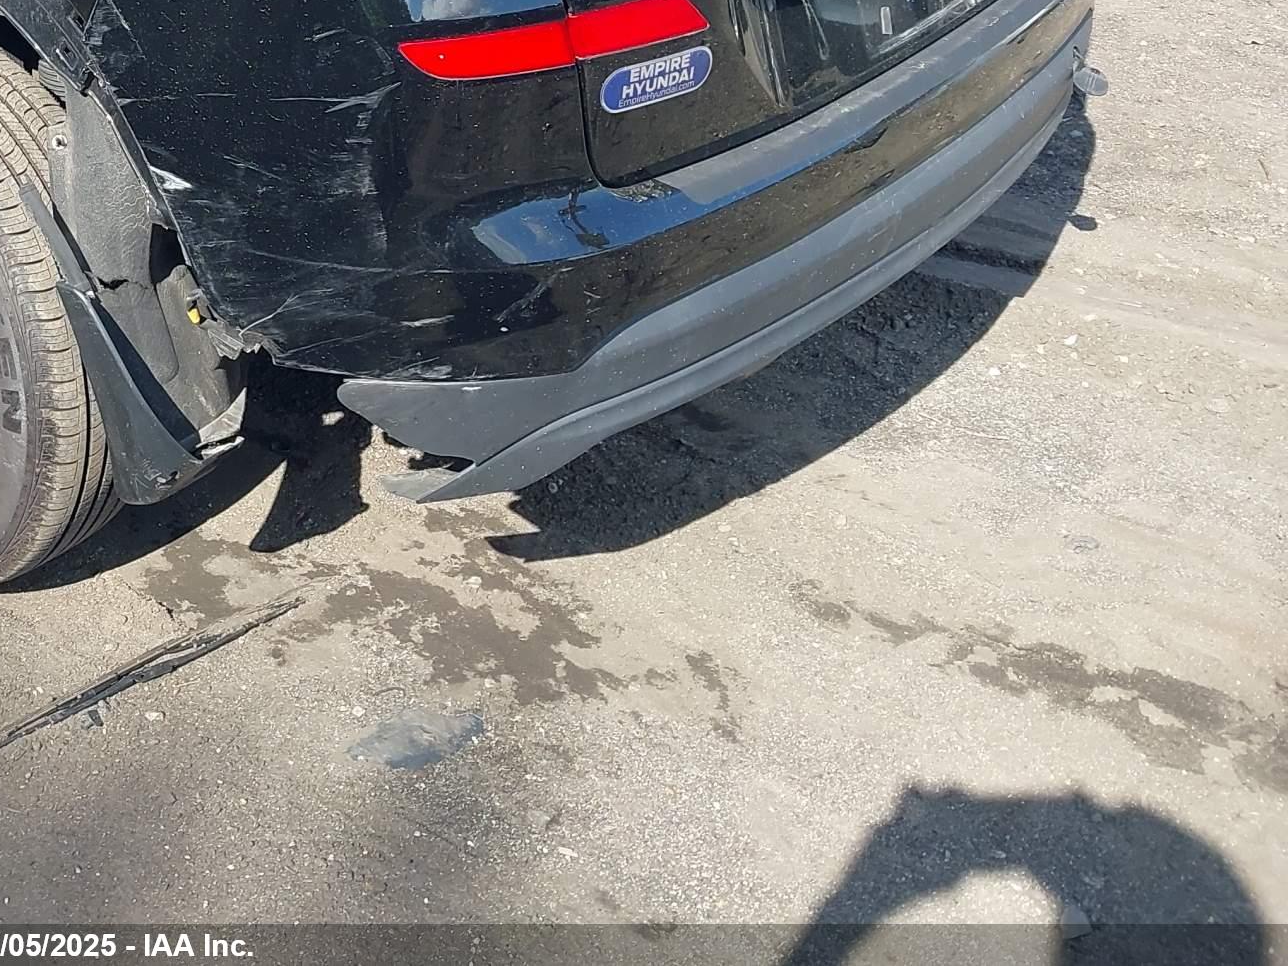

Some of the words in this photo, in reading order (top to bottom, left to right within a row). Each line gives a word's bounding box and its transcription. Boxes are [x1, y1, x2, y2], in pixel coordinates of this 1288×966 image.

[622, 66, 695, 99] HYUNDAI
[629, 54, 691, 83] EMPIRE
[618, 80, 695, 108] EmpireHyundai.com
